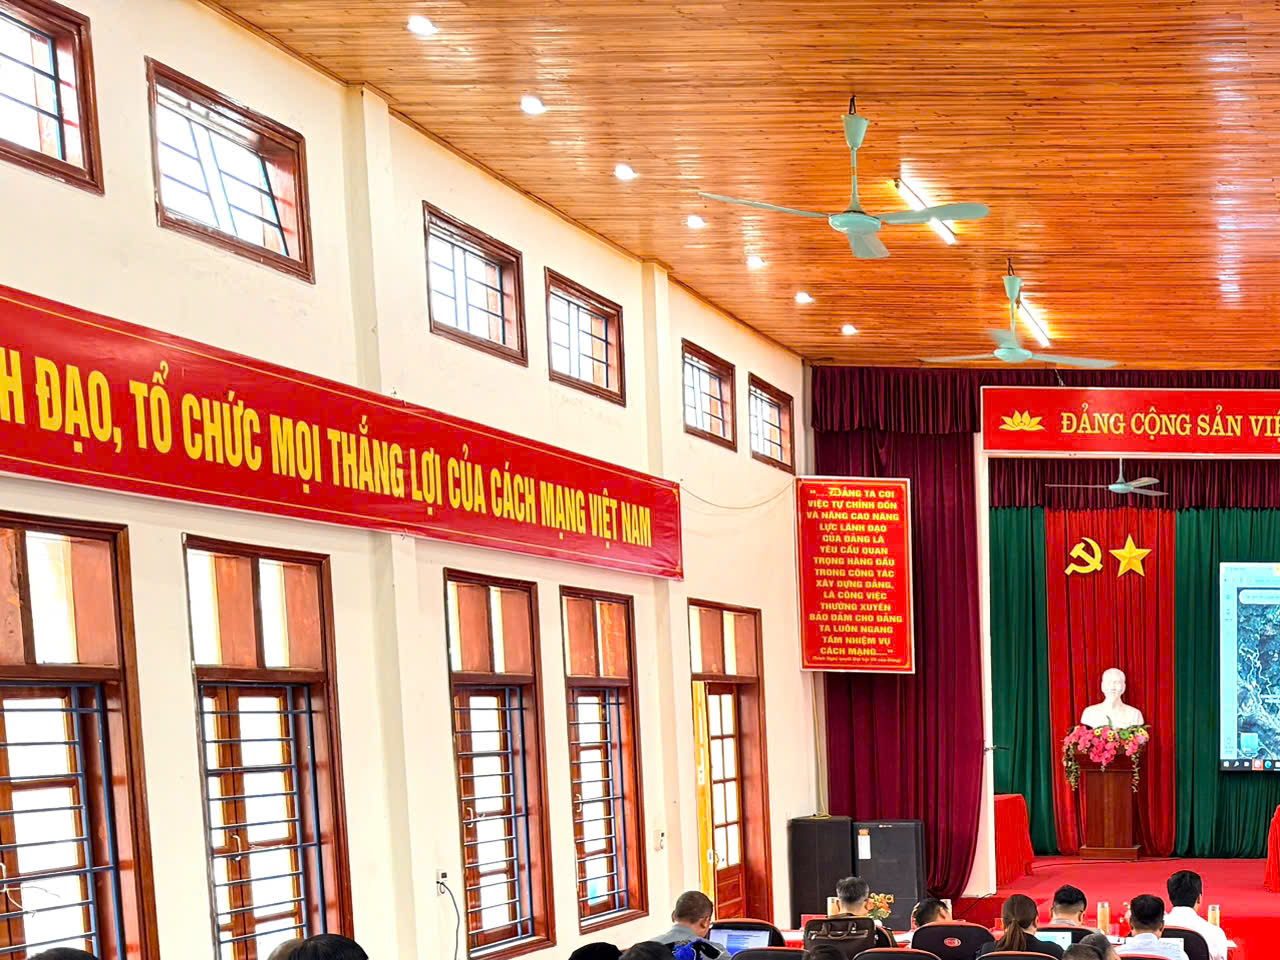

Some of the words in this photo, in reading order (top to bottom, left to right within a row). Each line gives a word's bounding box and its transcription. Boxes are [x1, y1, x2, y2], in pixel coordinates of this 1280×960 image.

[35, 356, 121, 453] ĐẠO,
[129, 360, 172, 454] TỔ
[182, 390, 262, 471] CHỨC
[270, 414, 321, 493] MỌI
[328, 415, 405, 498] THẮNG
[410, 448, 442, 515] LỢI
[448, 443, 486, 513] CỦA
[490, 461, 536, 523] CÁCH
[540, 480, 586, 539] MẠNG
[589, 488, 618, 548] VIỆT
[622, 502, 652, 547] NAM
[1060, 403, 1126, 434] ĐẢNG
[1130, 406, 1192, 440] CỘNG
[1197, 404, 1243, 437] SẢN
